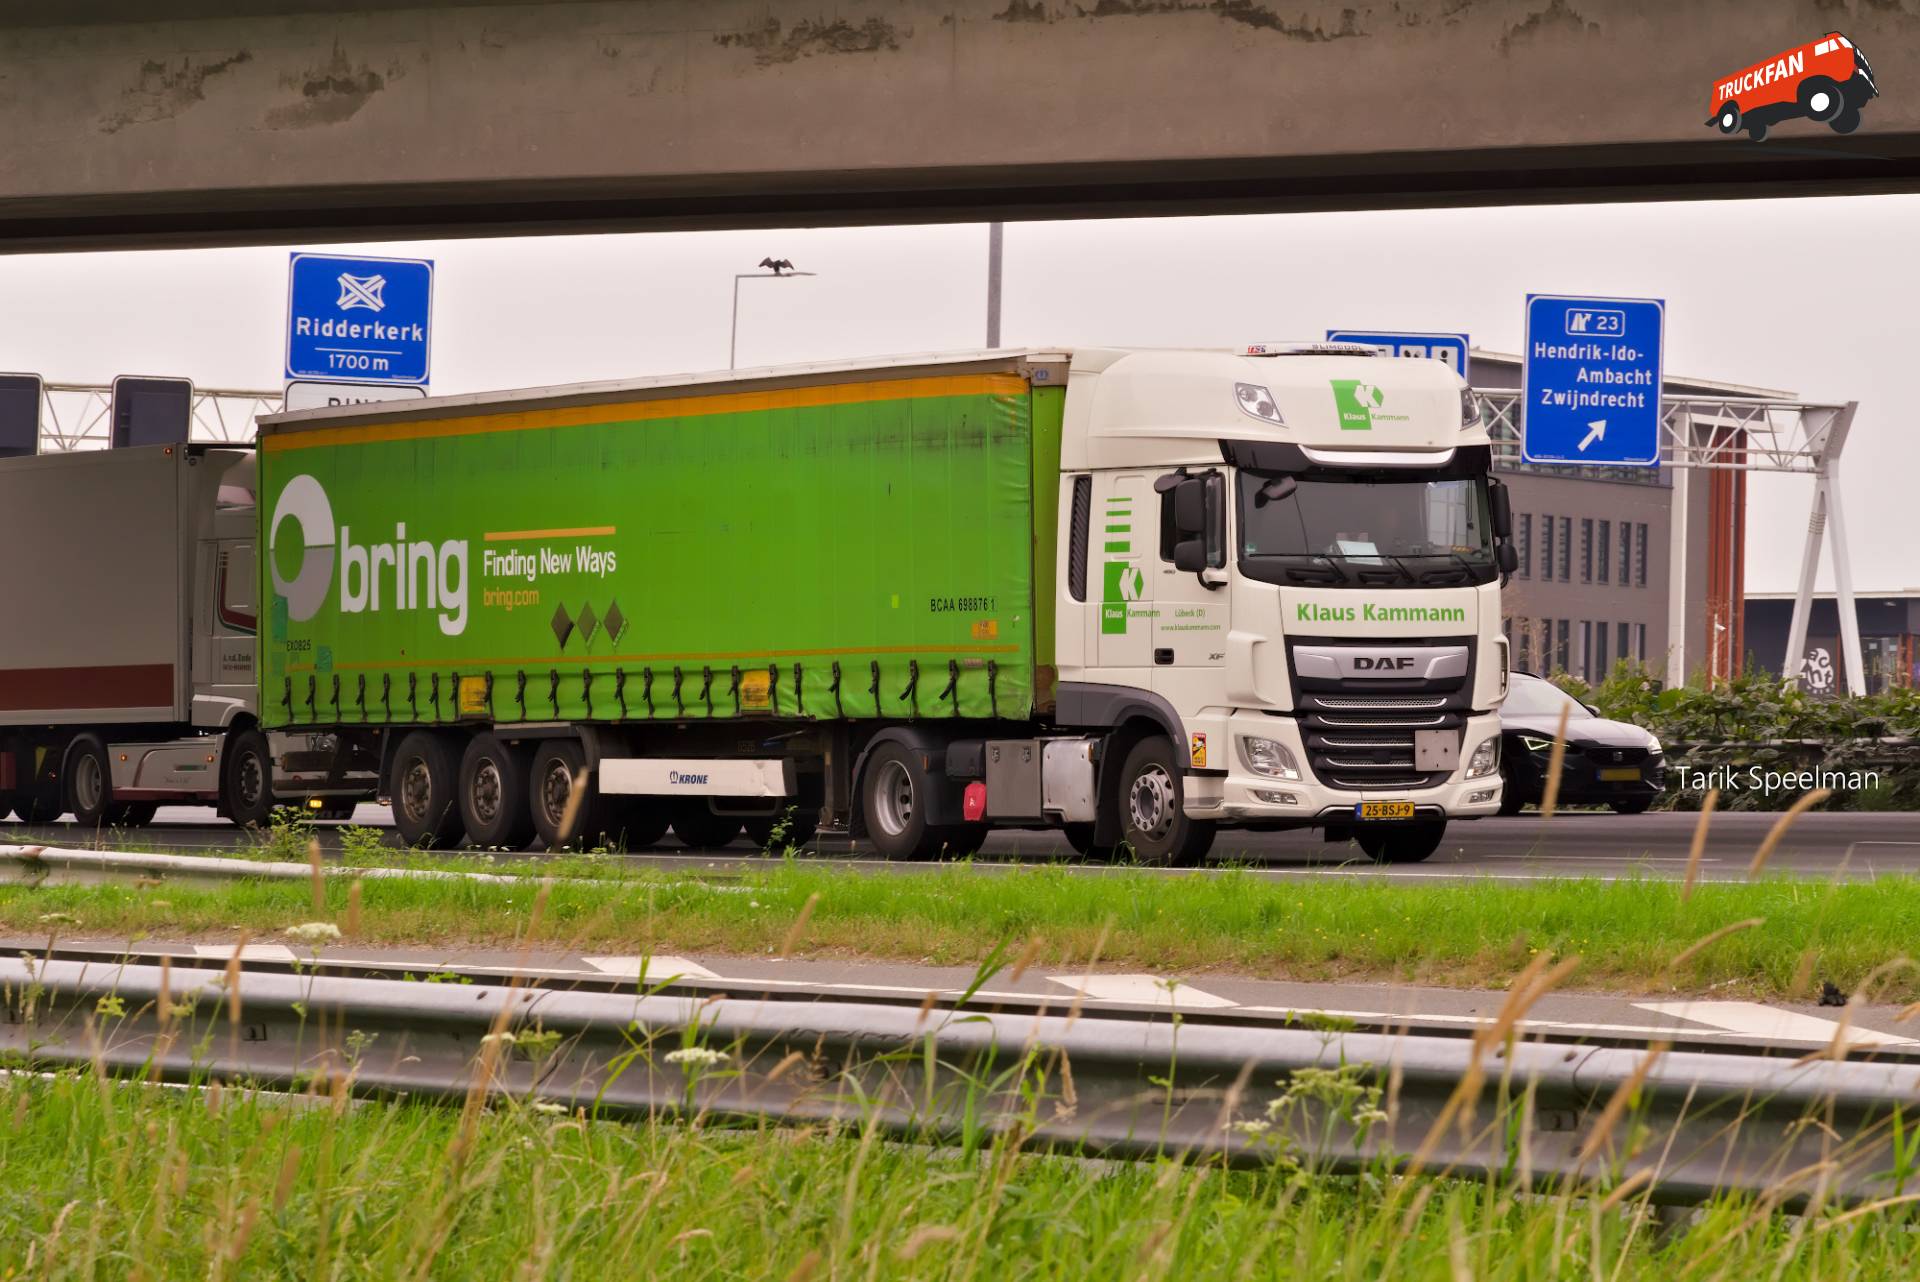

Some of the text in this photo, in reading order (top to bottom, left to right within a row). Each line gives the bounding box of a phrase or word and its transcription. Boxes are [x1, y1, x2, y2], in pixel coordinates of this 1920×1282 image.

[296, 317, 423, 341] Ridderkerk
[1596, 316, 1619, 330] 23
[1534, 342, 1644, 361] Hendrik-Ido-
[329, 354, 389, 371] 1700 m
[1576, 367, 1652, 385] Ambacht
[1541, 389, 1645, 410] Zwijndrecht
[1344, 413, 1410, 422] Klaus Kammann
[483, 545, 616, 582] Finding New Ways
[340, 522, 468, 636] bring
[483, 587, 540, 612] bring.com
[930, 598, 955, 612] BCAA
[958, 597, 988, 611] 698876
[1105, 609, 1123, 618] Klaus
[1127, 609, 1160, 618] Kammann
[1297, 603, 1465, 622] Klaus Kammann
[1208, 653, 1225, 661] XF
[1353, 657, 1415, 670] DAF
[679, 774, 708, 785] KRONE
[1366, 804, 1410, 816] 25-BSJ-9
